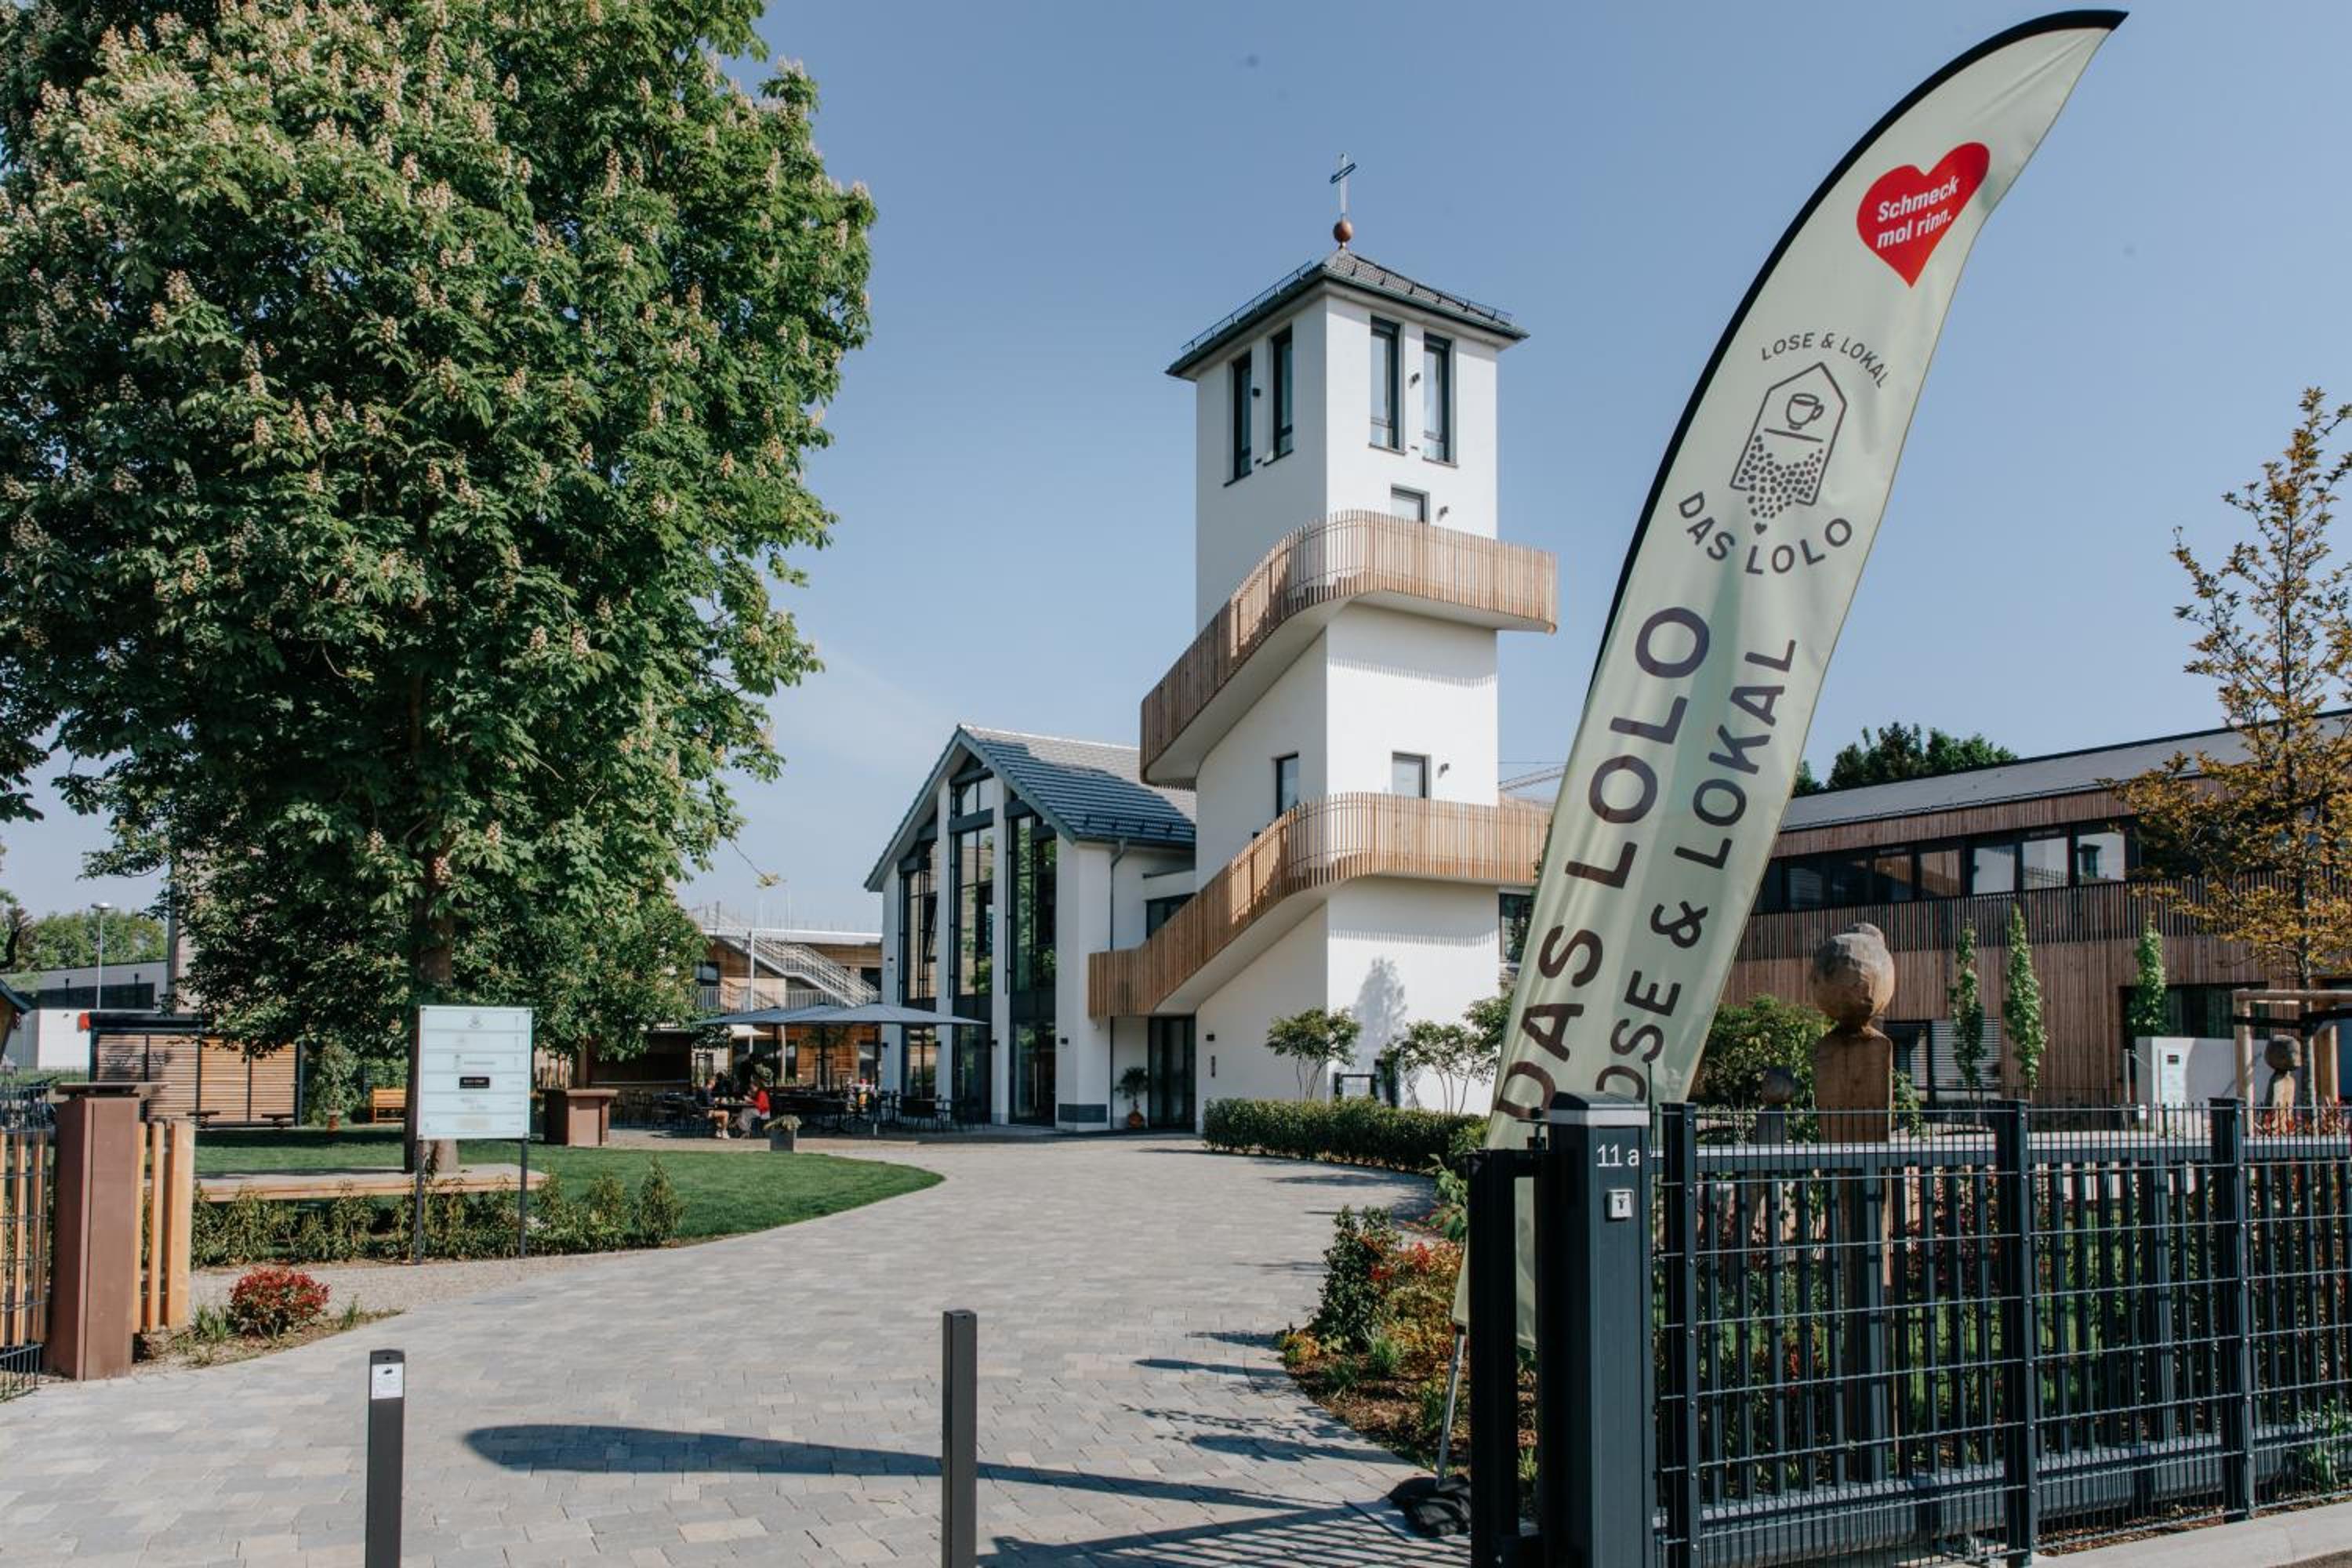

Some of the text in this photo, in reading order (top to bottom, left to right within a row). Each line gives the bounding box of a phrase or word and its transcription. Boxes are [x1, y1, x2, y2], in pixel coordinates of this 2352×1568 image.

[1877, 176, 1959, 223] Schmeck
[1877, 209, 1952, 249] mol rinn.
[1761, 332, 1890, 389] LOSE & LOKAL
[1679, 491, 1853, 575] DAS LOLO
[1493, 607, 1710, 1119] DAS LOLO
[1595, 639, 1795, 1102] OSE & LOKAL
